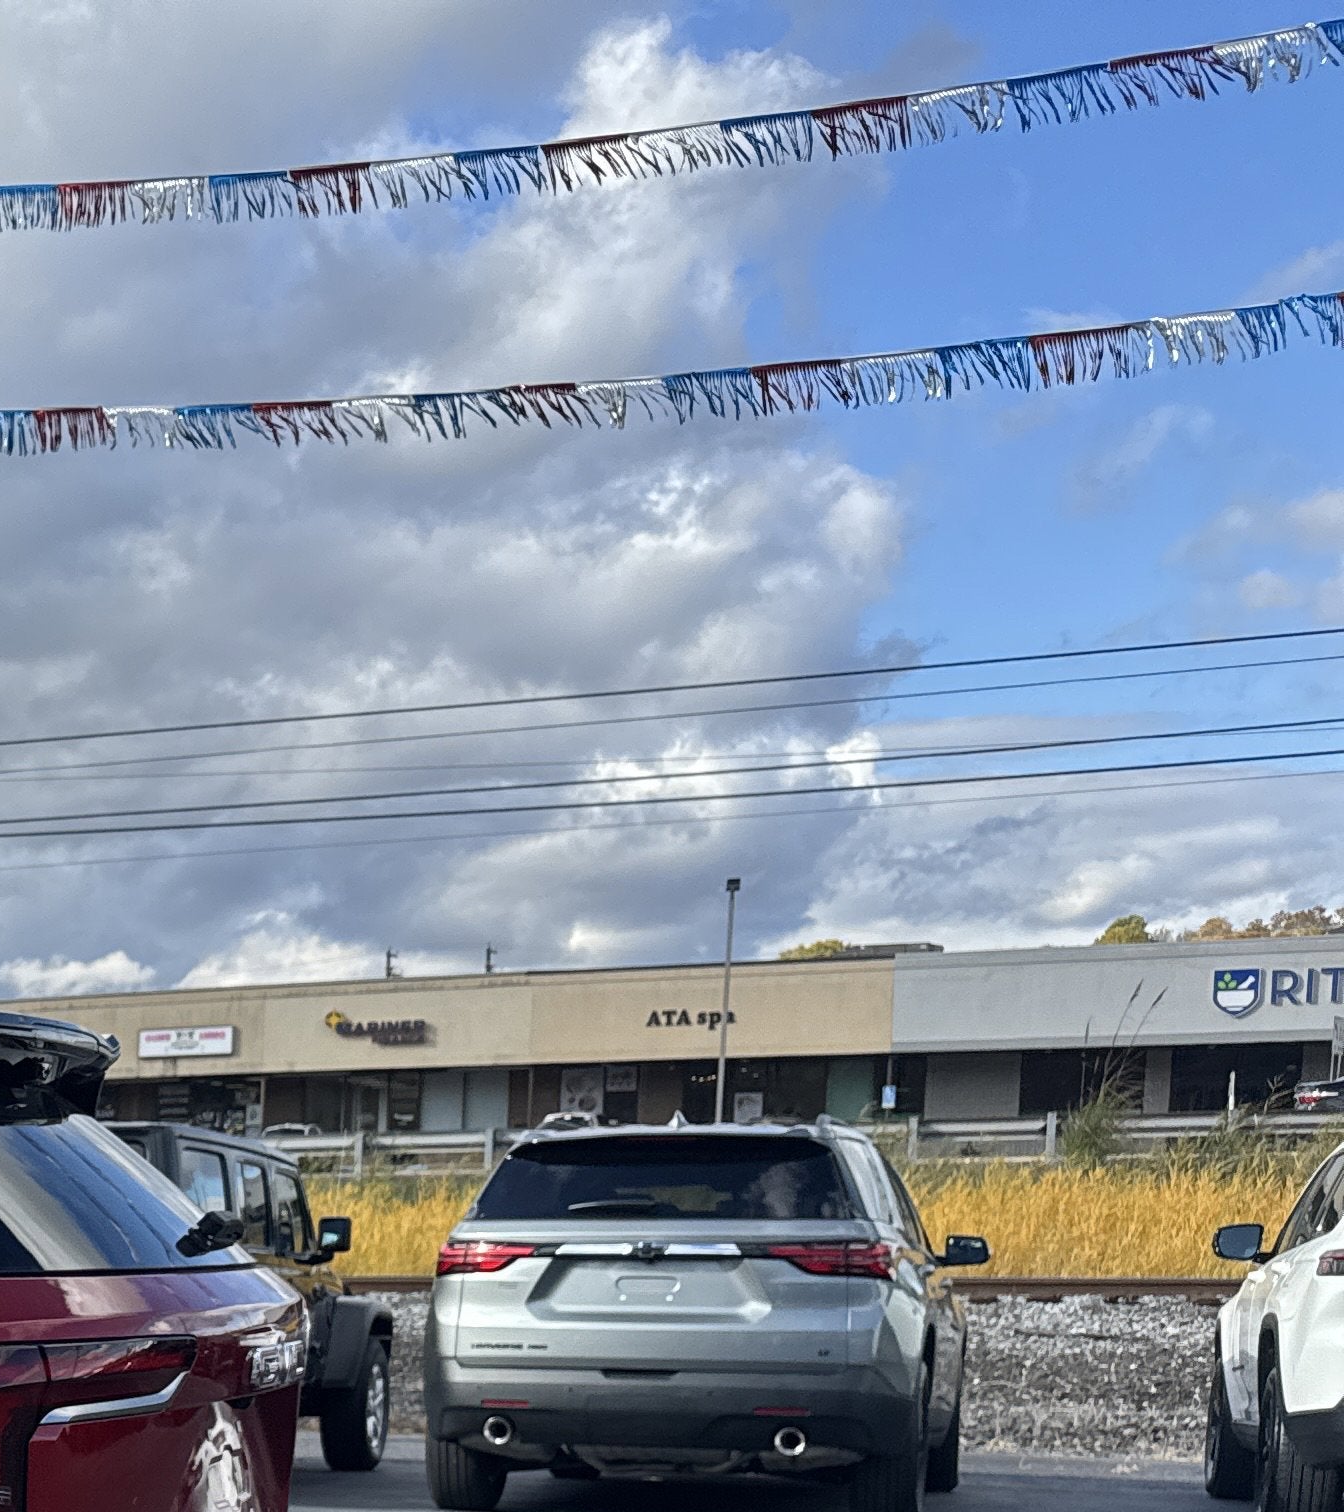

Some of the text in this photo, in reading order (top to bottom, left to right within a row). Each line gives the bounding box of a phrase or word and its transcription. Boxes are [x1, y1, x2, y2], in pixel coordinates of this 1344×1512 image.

[1270, 967, 1344, 1005] RIT
[646, 1009, 736, 1031] ATA spa
